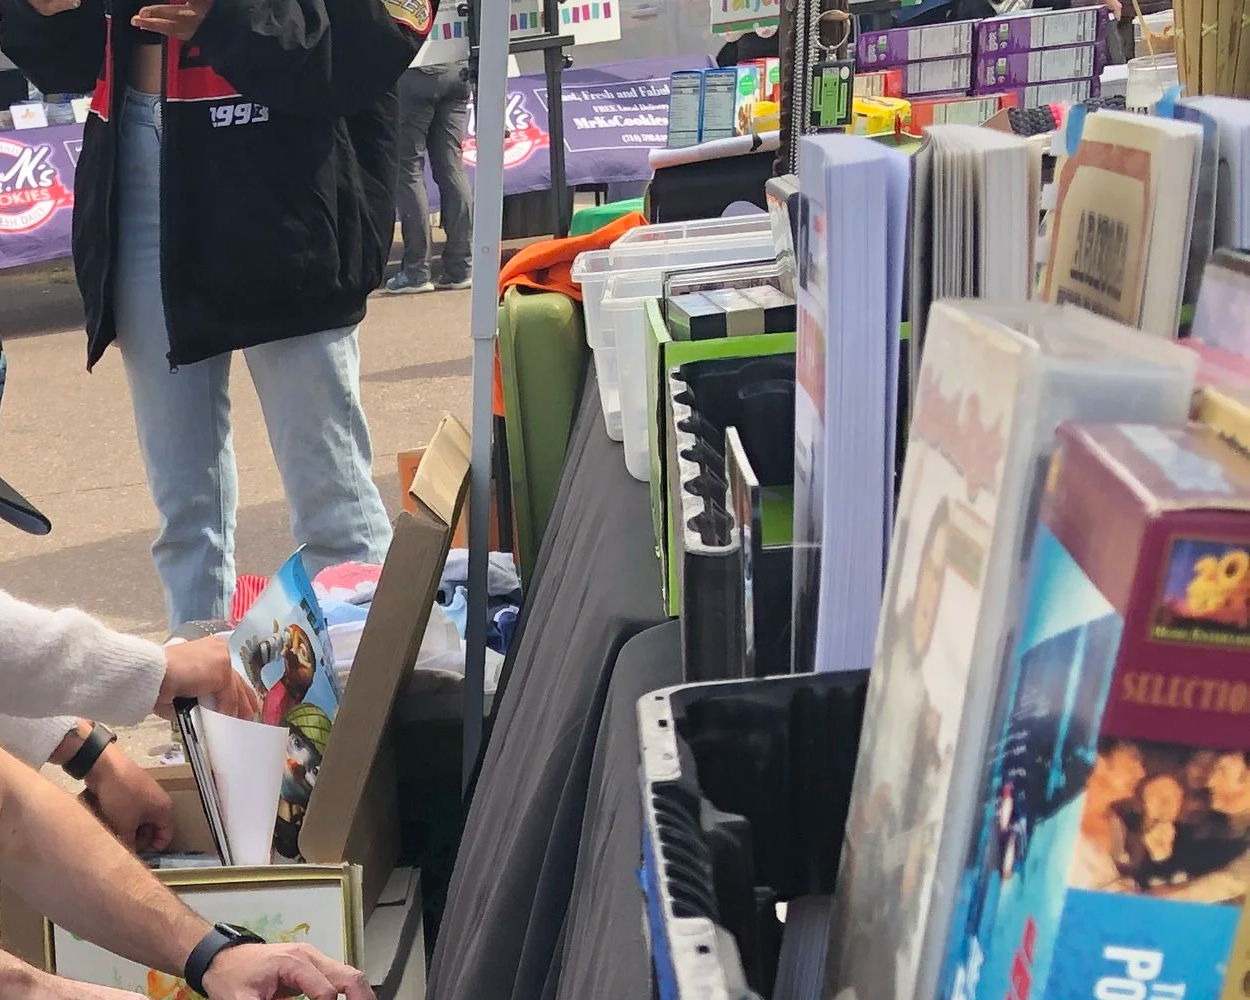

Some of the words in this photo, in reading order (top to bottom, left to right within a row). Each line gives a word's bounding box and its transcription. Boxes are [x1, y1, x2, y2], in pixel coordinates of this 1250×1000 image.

[581, 90, 615, 100] Fresh
[616, 87, 638, 98] and
[639, 84, 670, 97] Fabul
[210, 103, 269, 127] 1993
[1123, 671, 1250, 715] SELECTIO
